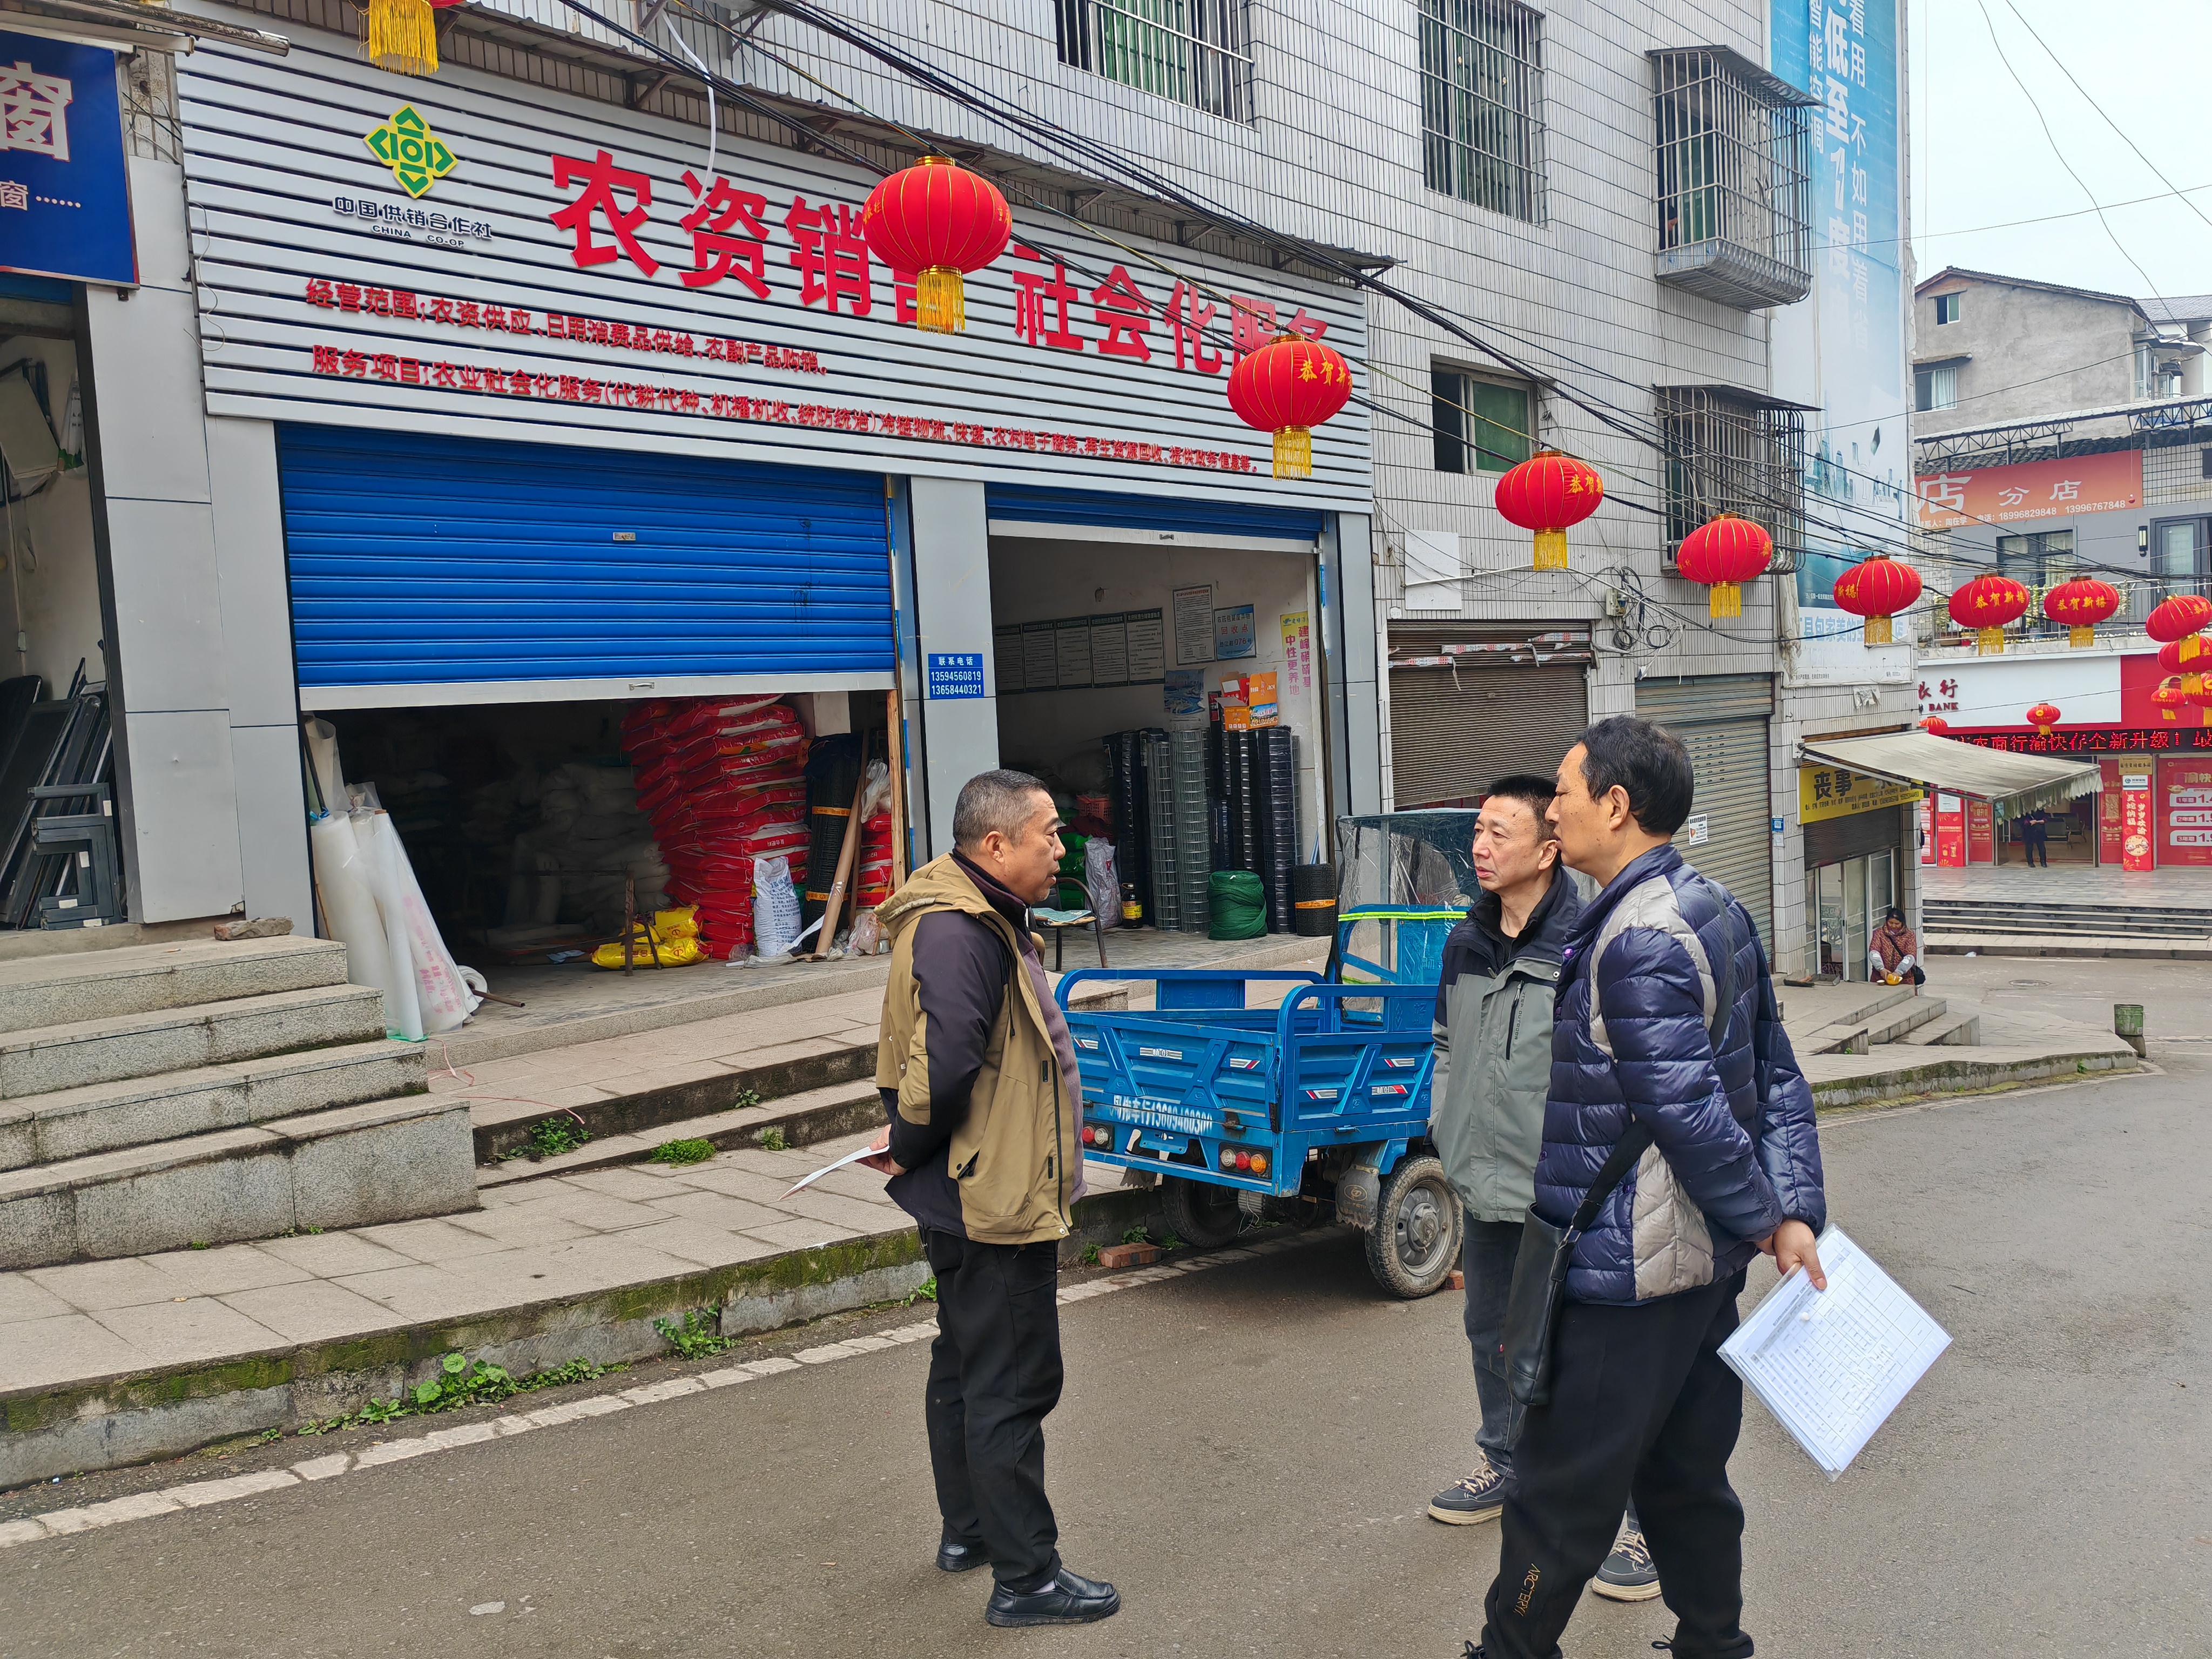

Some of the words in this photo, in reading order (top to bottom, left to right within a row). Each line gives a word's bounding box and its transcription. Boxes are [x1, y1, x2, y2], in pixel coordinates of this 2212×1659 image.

[334, 197, 492, 239] 中国供销合作社
[373, 225, 412, 238] CHINA
[427, 235, 464, 247] CO-OP
[1999, 507, 2057, 521] 18996829848
[2065, 500, 2126, 514] 13996767848
[1973, 591, 2026, 609] 恭贺新禧
[2057, 595, 2107, 611] 恭贺新禧
[939, 656, 973, 666] 联系电话
[931, 671, 981, 682] 13594560819
[932, 685, 981, 695] 13658440321
[1928, 702, 1959, 711] BANK
